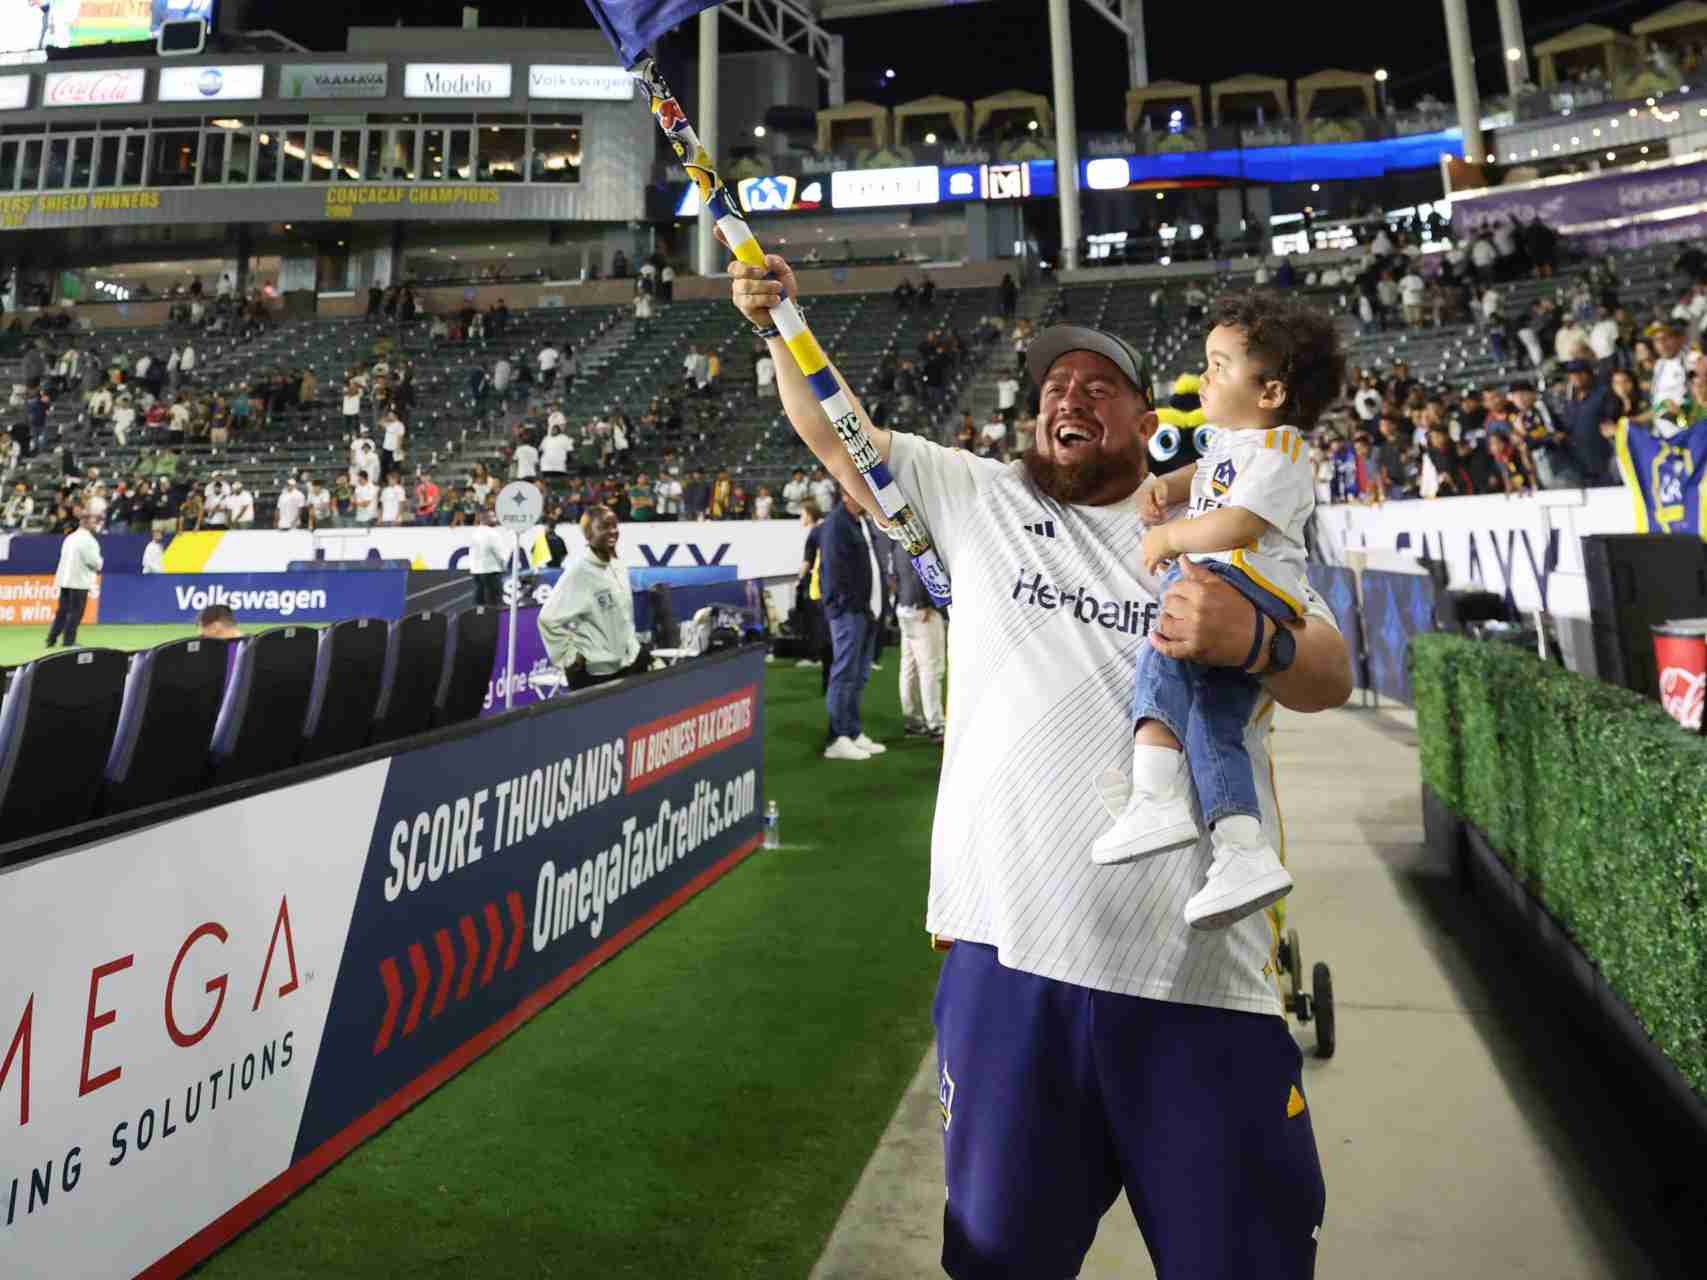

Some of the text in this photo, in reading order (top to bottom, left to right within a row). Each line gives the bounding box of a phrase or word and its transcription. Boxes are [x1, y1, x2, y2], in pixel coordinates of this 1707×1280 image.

[425, 73, 492, 95] Modelo
[91, 192, 160, 208] WINNERS
[327, 186, 497, 204] CONCACAF CHAMPIONS
[175, 585, 327, 616] Volkswagen
[1012, 568, 1158, 638] Herbalif
[631, 697, 752, 780] IN BUSINESS TAX CREDITS
[384, 738, 626, 902] SCORE THOUSANDS
[532, 768, 756, 952] OmegaTaxCredits.com
[109, 1031, 294, 1167] SOLUTIONS
